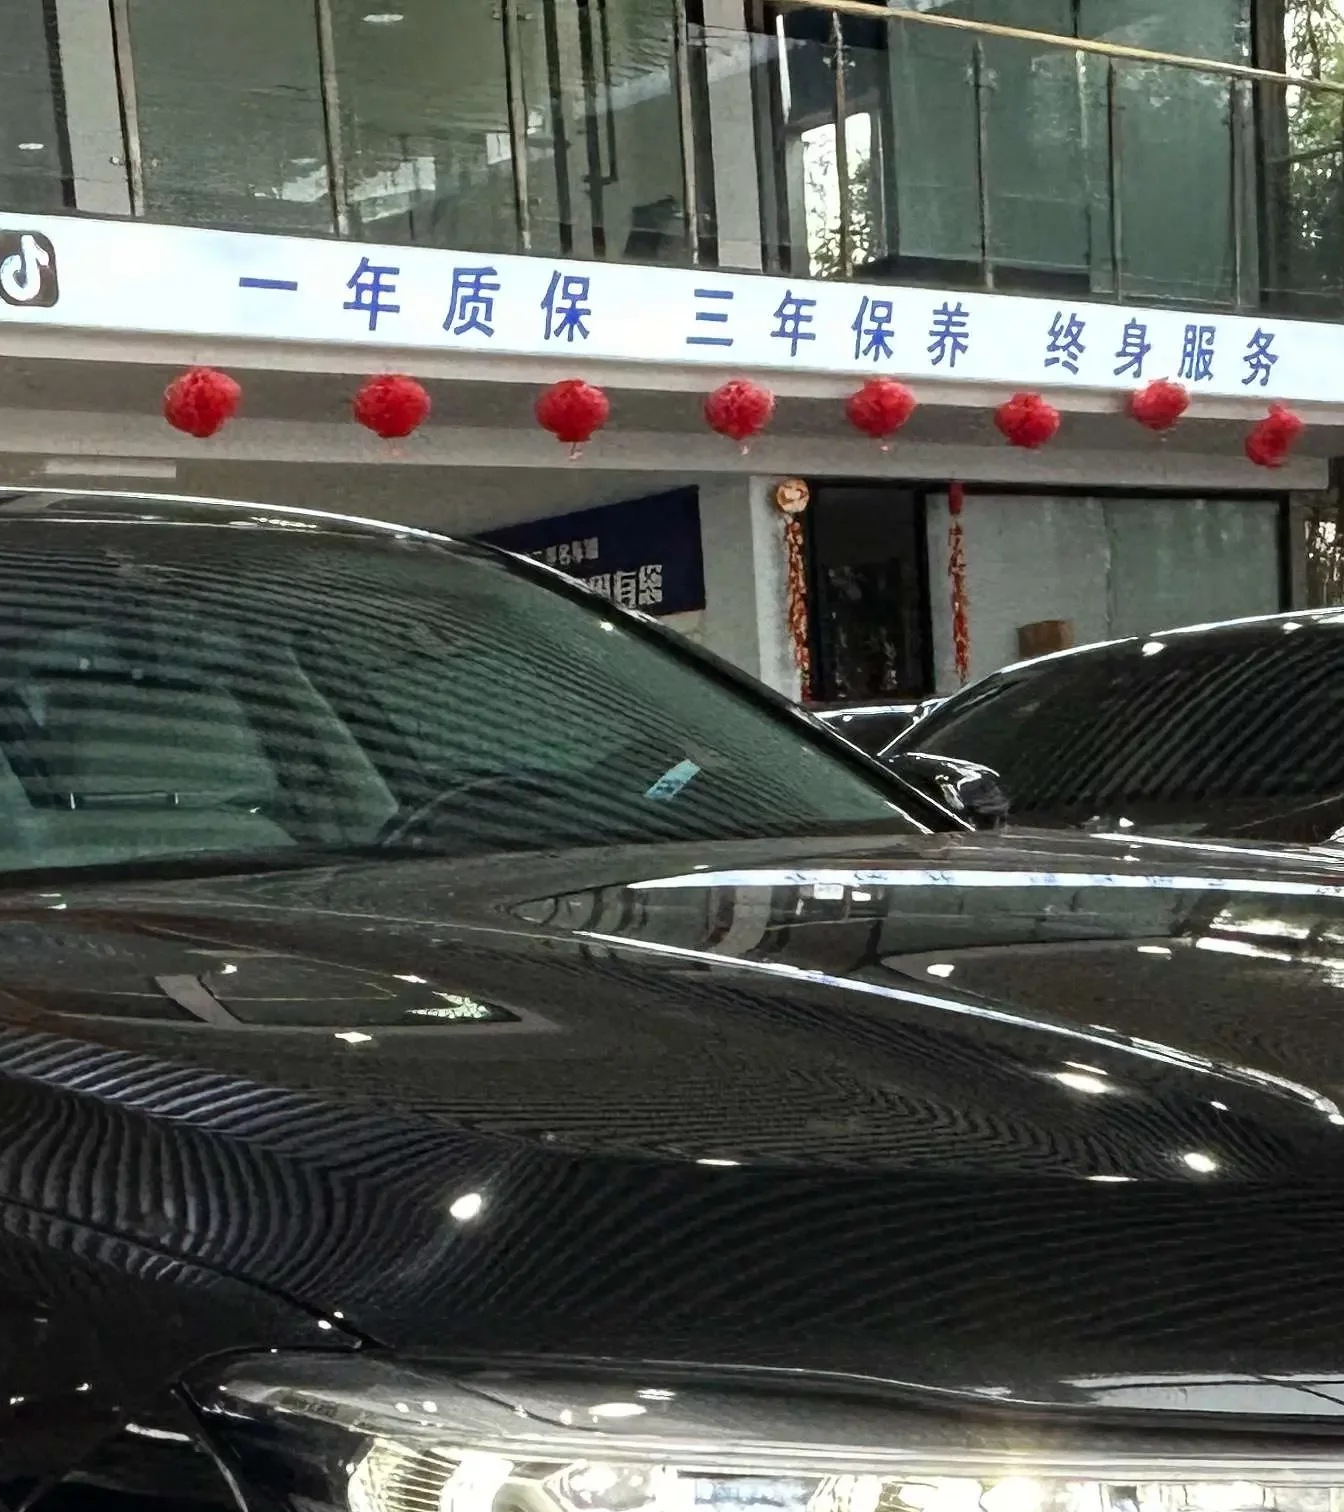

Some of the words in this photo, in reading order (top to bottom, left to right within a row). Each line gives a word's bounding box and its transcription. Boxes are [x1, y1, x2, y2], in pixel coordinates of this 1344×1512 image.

[239, 256, 592, 343] 一年质保
[686, 288, 972, 366] 三年保养
[1044, 310, 1280, 386] 终身服务
